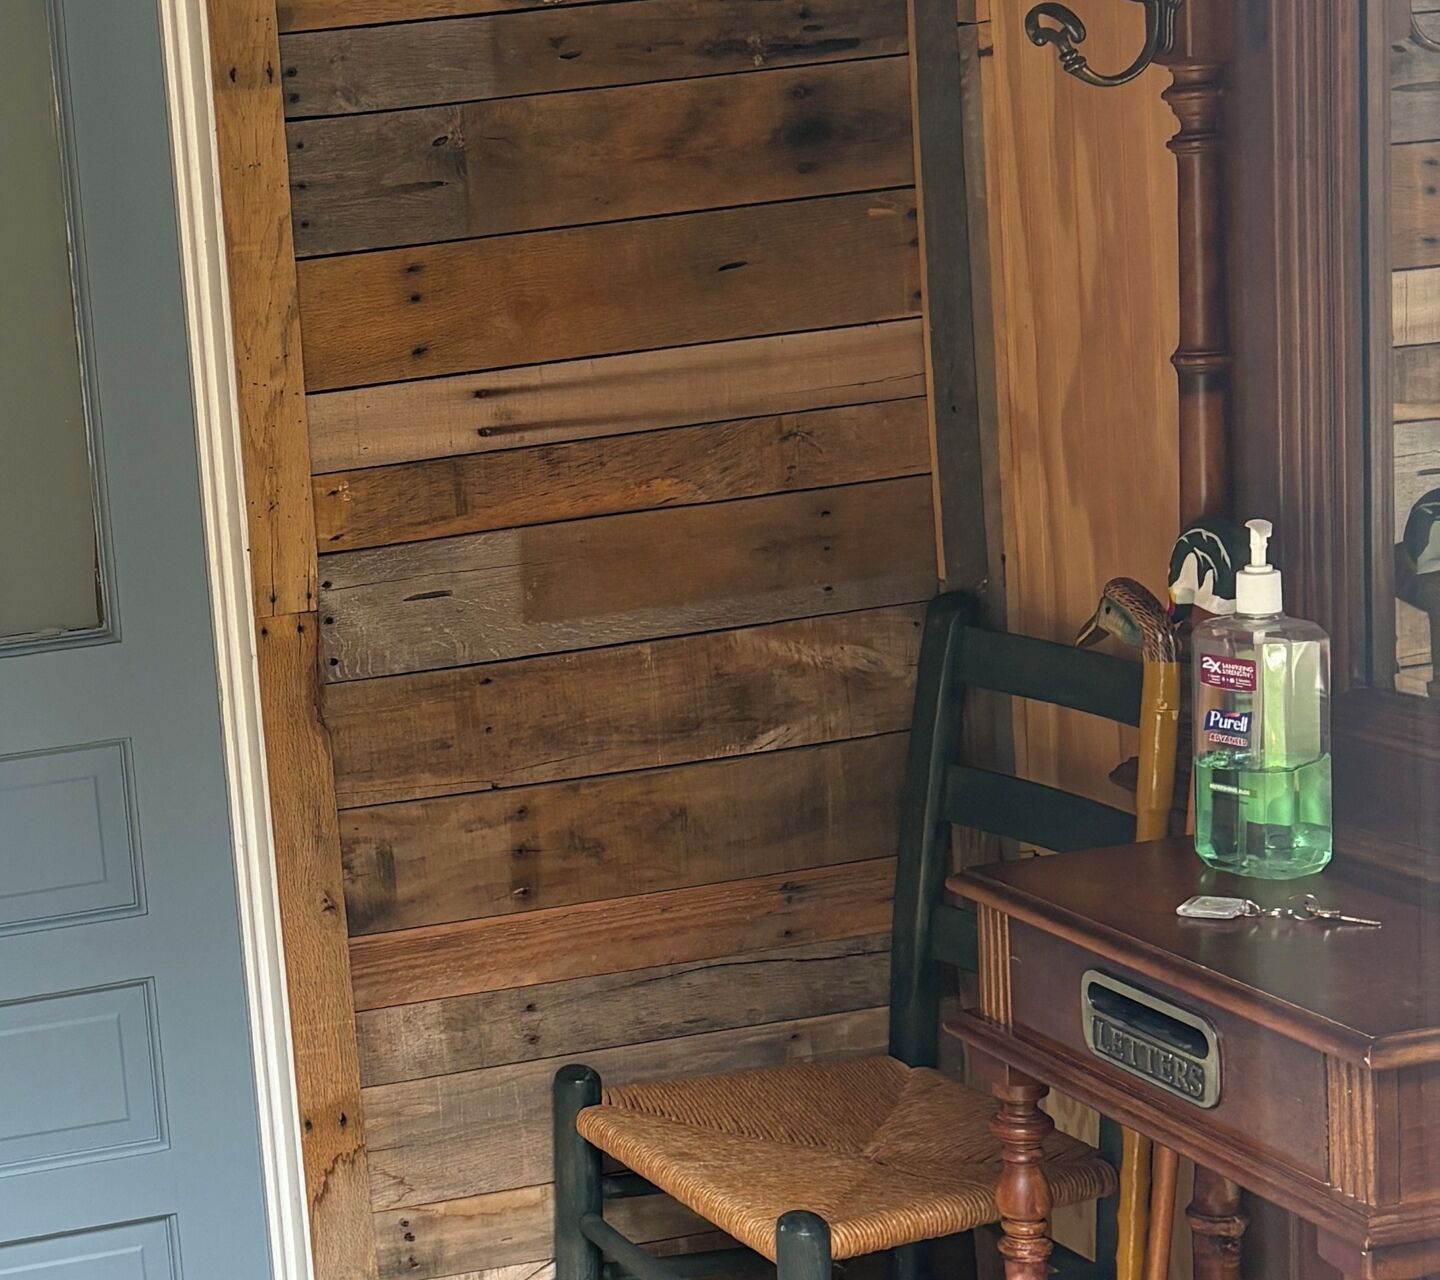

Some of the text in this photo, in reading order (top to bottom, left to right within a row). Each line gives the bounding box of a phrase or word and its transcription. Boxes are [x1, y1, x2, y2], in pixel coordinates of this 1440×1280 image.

[1202, 656, 1221, 673] 2X
[1209, 710, 1248, 732] Purell
[1094, 1021, 1202, 1097] LETTERS
